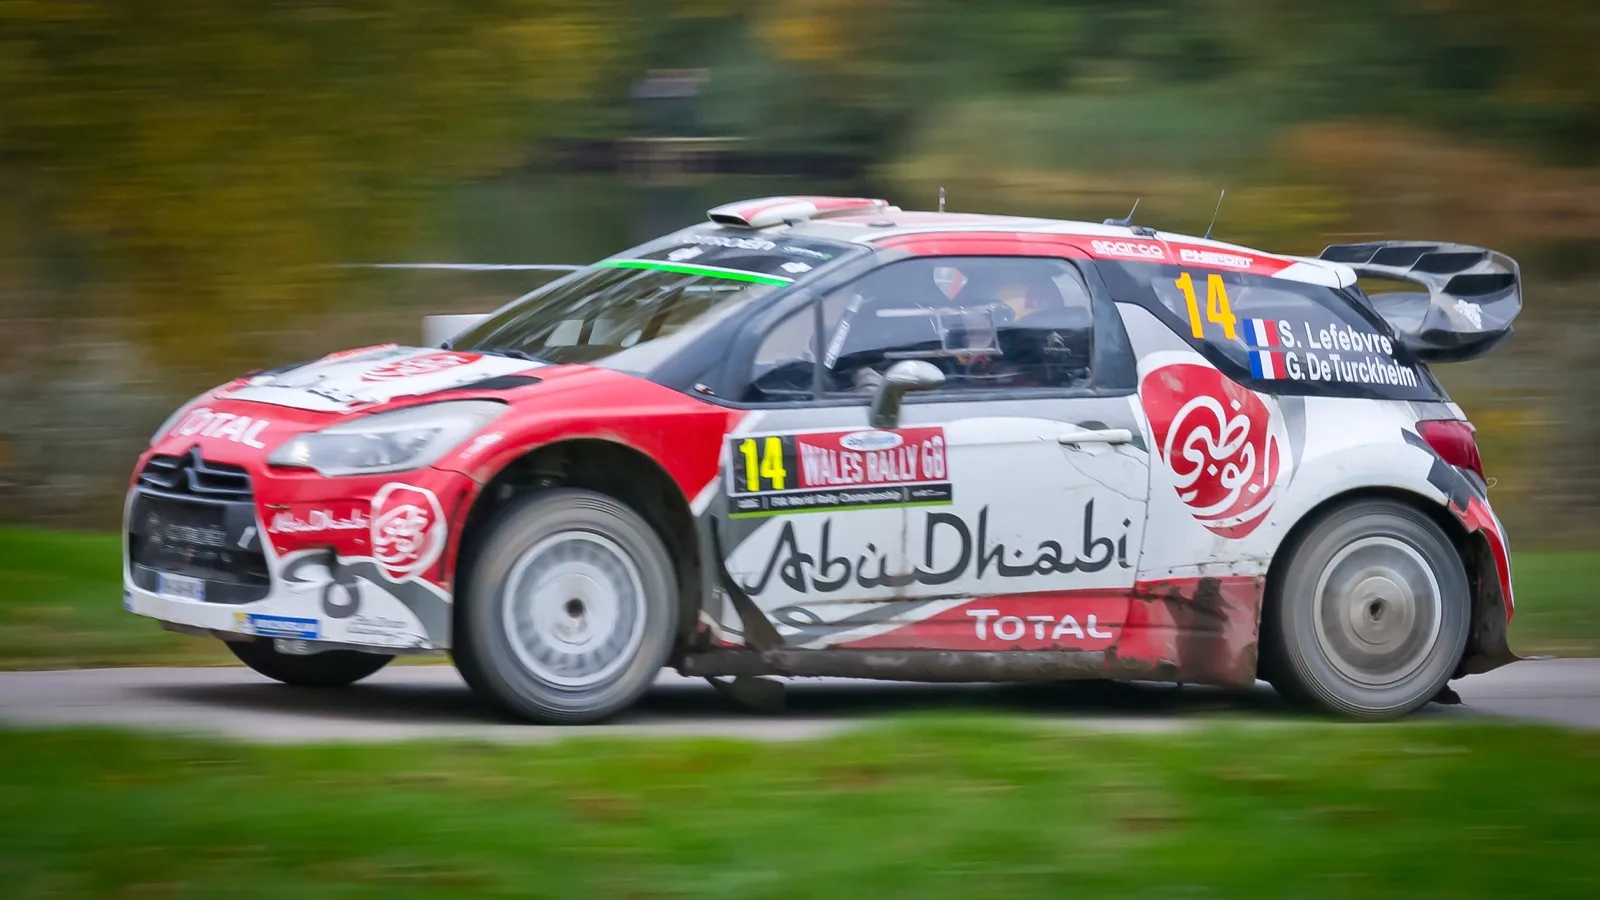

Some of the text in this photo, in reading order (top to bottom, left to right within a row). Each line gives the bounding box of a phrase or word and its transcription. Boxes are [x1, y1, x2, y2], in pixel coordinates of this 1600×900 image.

[1091, 240, 1164, 258] sparco
[1175, 272, 1237, 339] 14
[1278, 319, 1393, 355] S. Lefebvre
[1285, 351, 1306, 381] G.
[167, 407, 271, 450] TOTAL
[739, 436, 787, 492] 14
[799, 442, 864, 487] WALES
[866, 443, 918, 482] RALLY
[742, 497, 1133, 597] Abu Dhabi
[966, 609, 1113, 642] TOTAL
